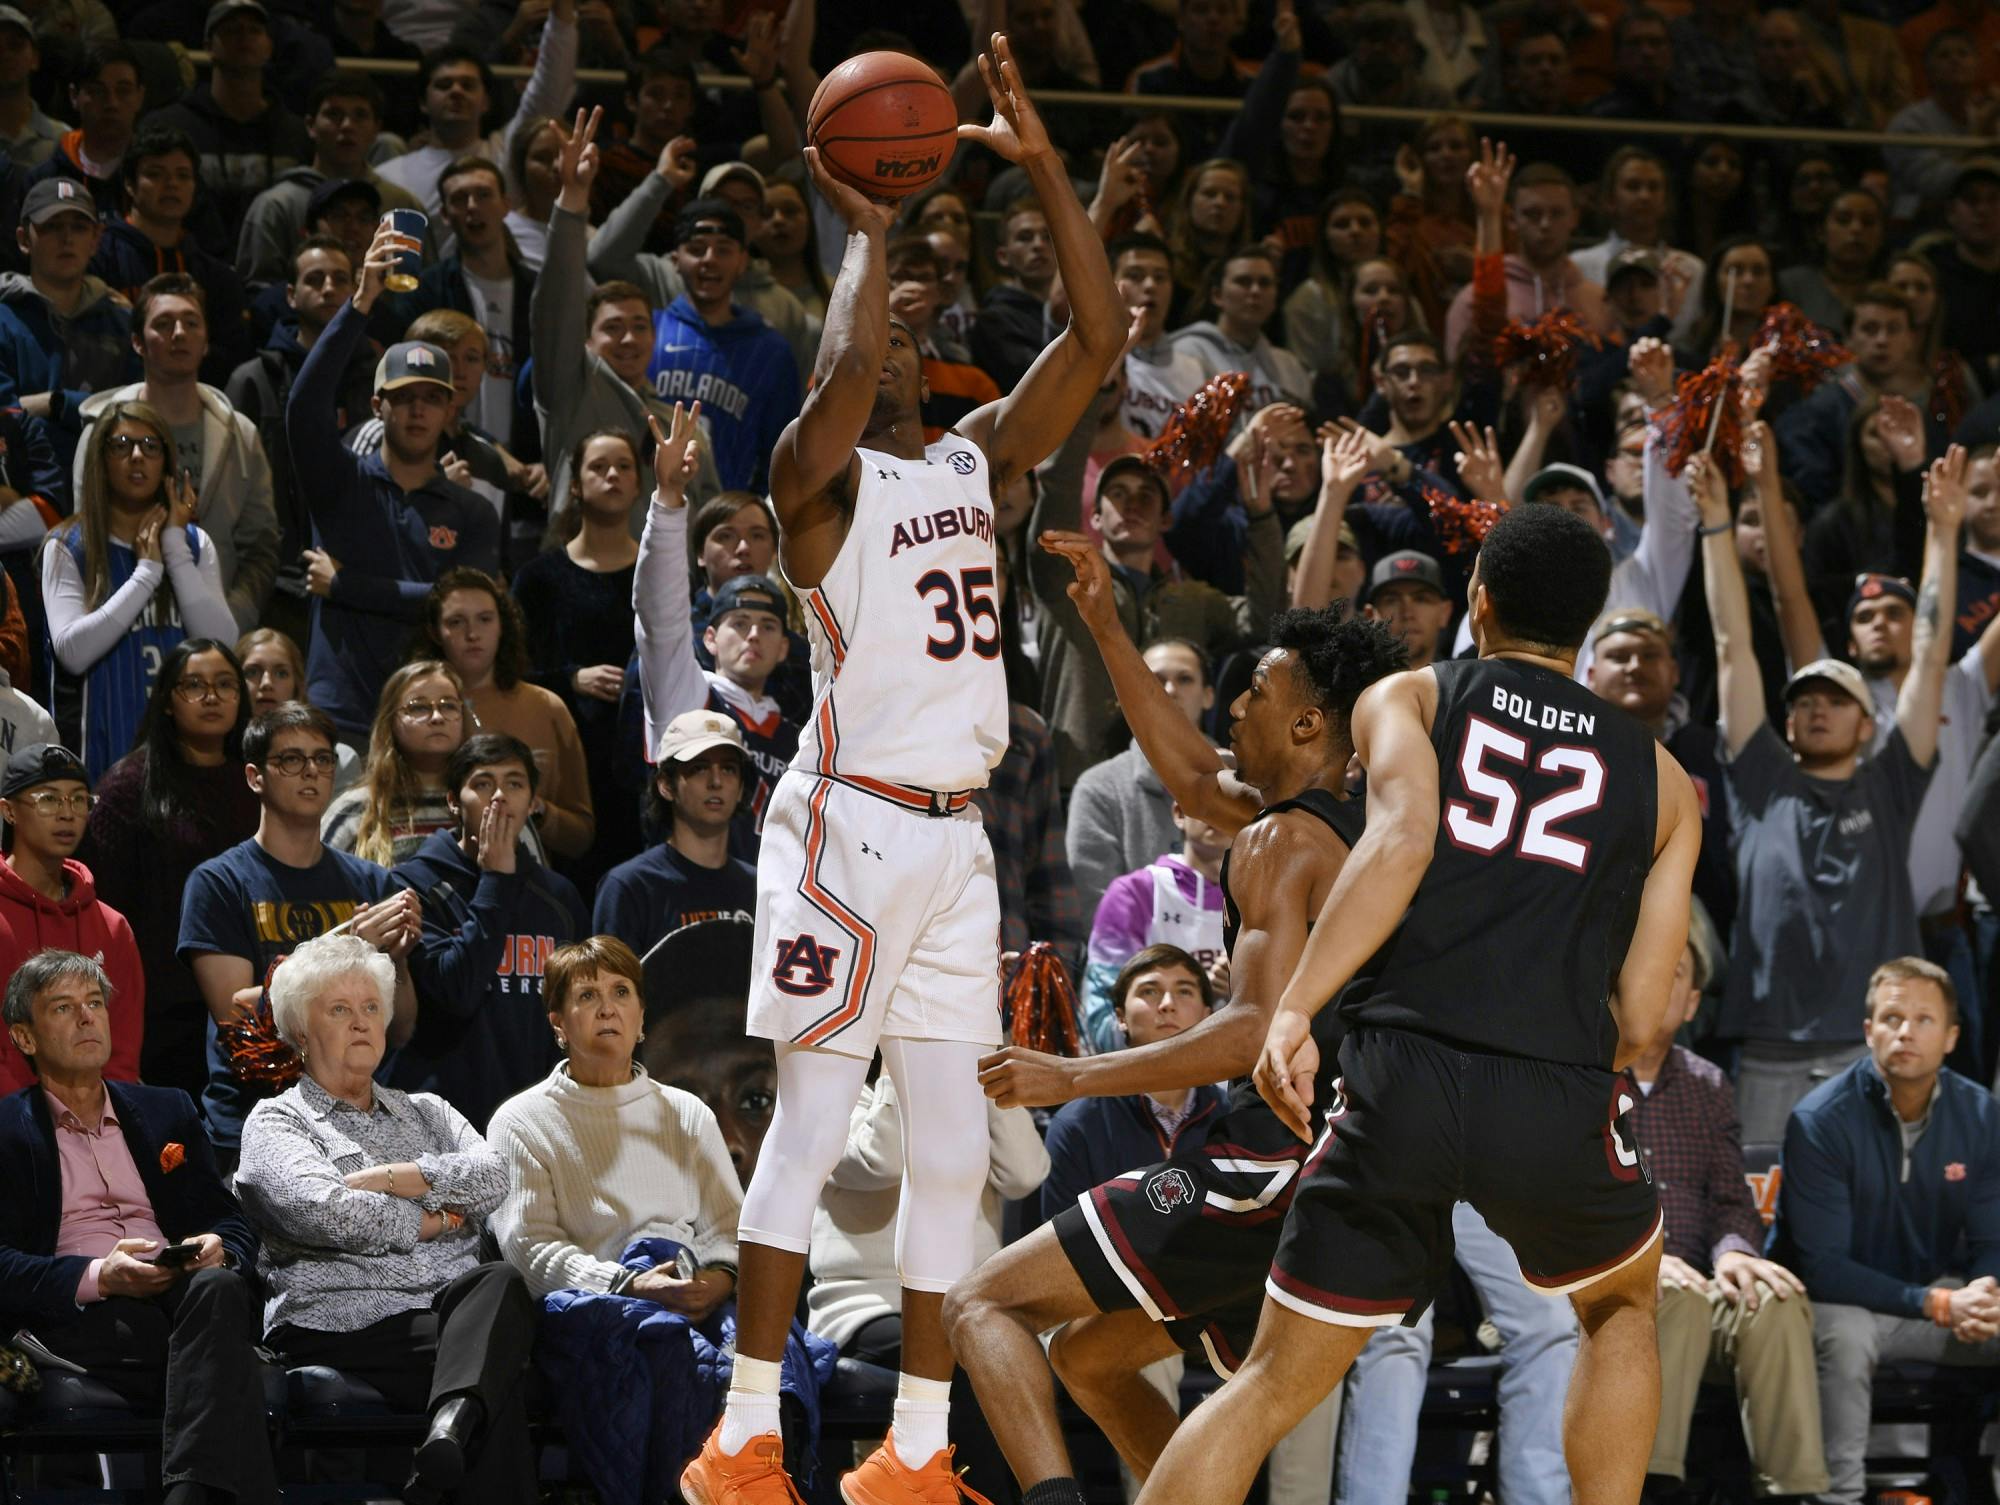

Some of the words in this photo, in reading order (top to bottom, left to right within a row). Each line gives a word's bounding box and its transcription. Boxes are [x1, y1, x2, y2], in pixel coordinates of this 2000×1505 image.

[875, 152, 943, 178] NCAA
[655, 369, 750, 421] ORLANDO
[889, 506, 994, 558] AUBURN
[914, 565, 1001, 662] 35
[1492, 685, 1595, 736] BOLDEN
[1442, 711, 1609, 876] 52
